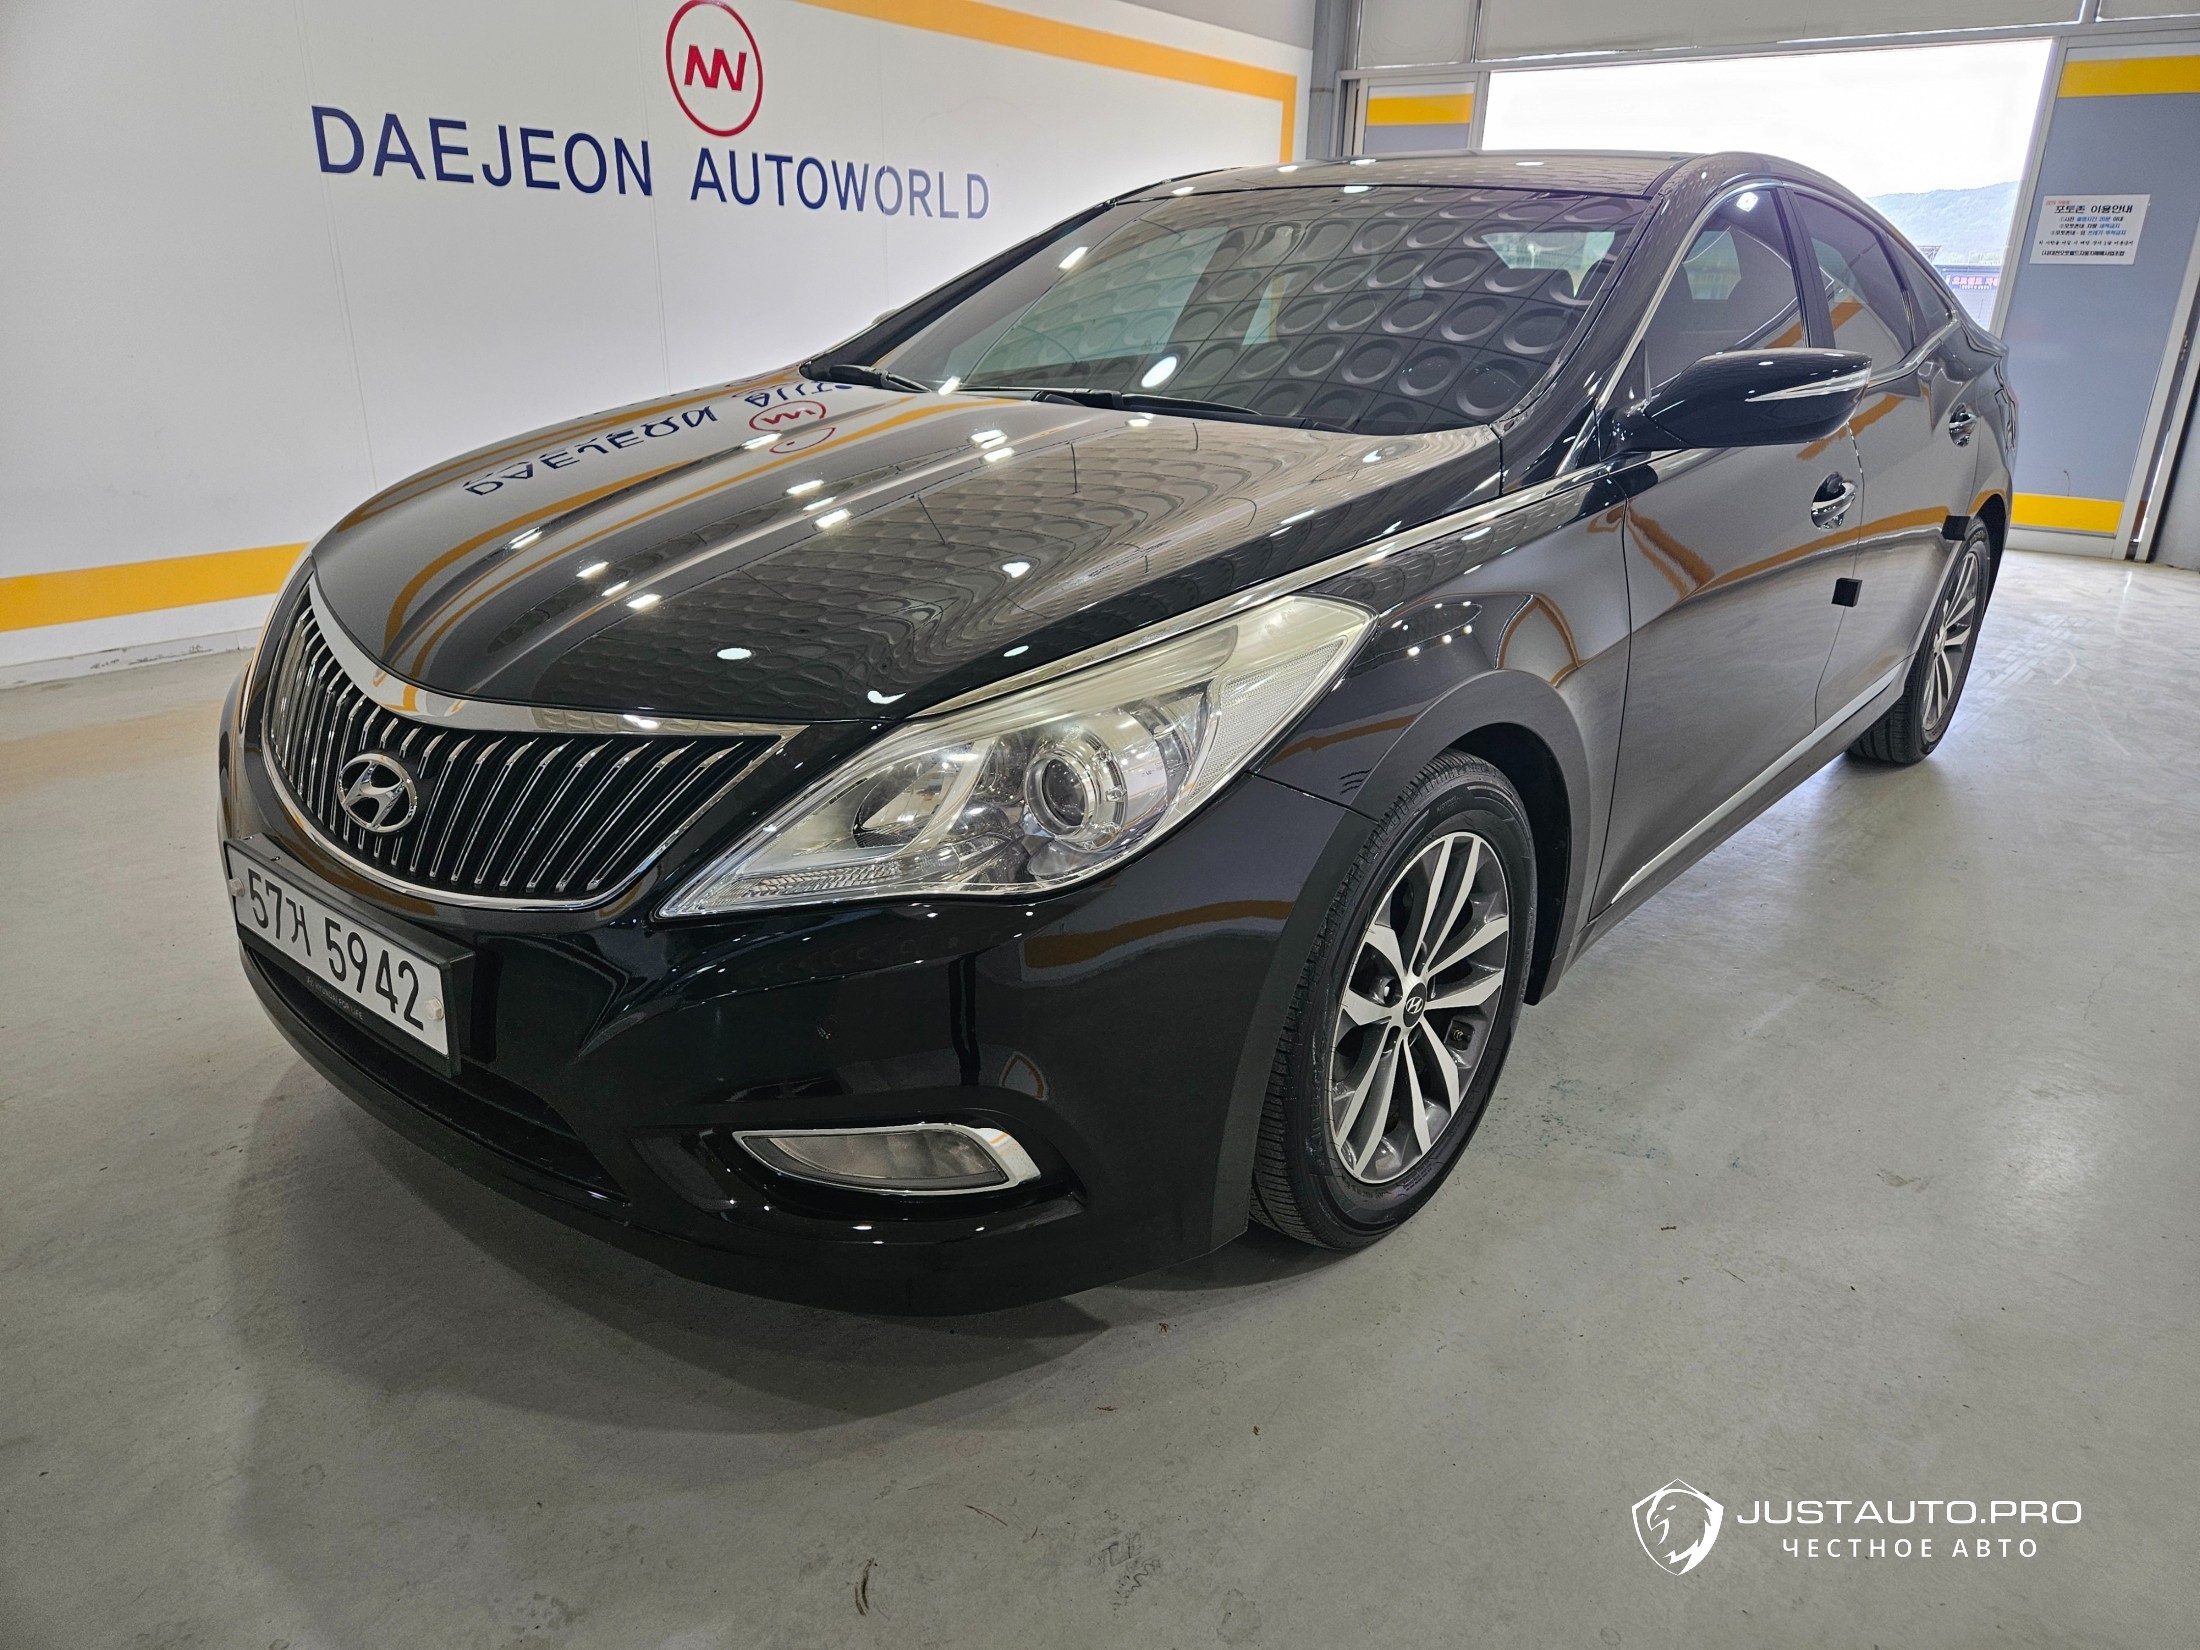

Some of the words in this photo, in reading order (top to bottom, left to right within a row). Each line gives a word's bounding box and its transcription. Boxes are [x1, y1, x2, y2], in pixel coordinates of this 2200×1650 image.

[312, 105, 653, 197] DAEJEON
[690, 147, 990, 220] AUTOWORLD
[2054, 204, 2086, 214] 포토존
[2090, 204, 2133, 214] 이용안내
[248, 867, 312, 957] 57거
[324, 916, 425, 1031] 5942
